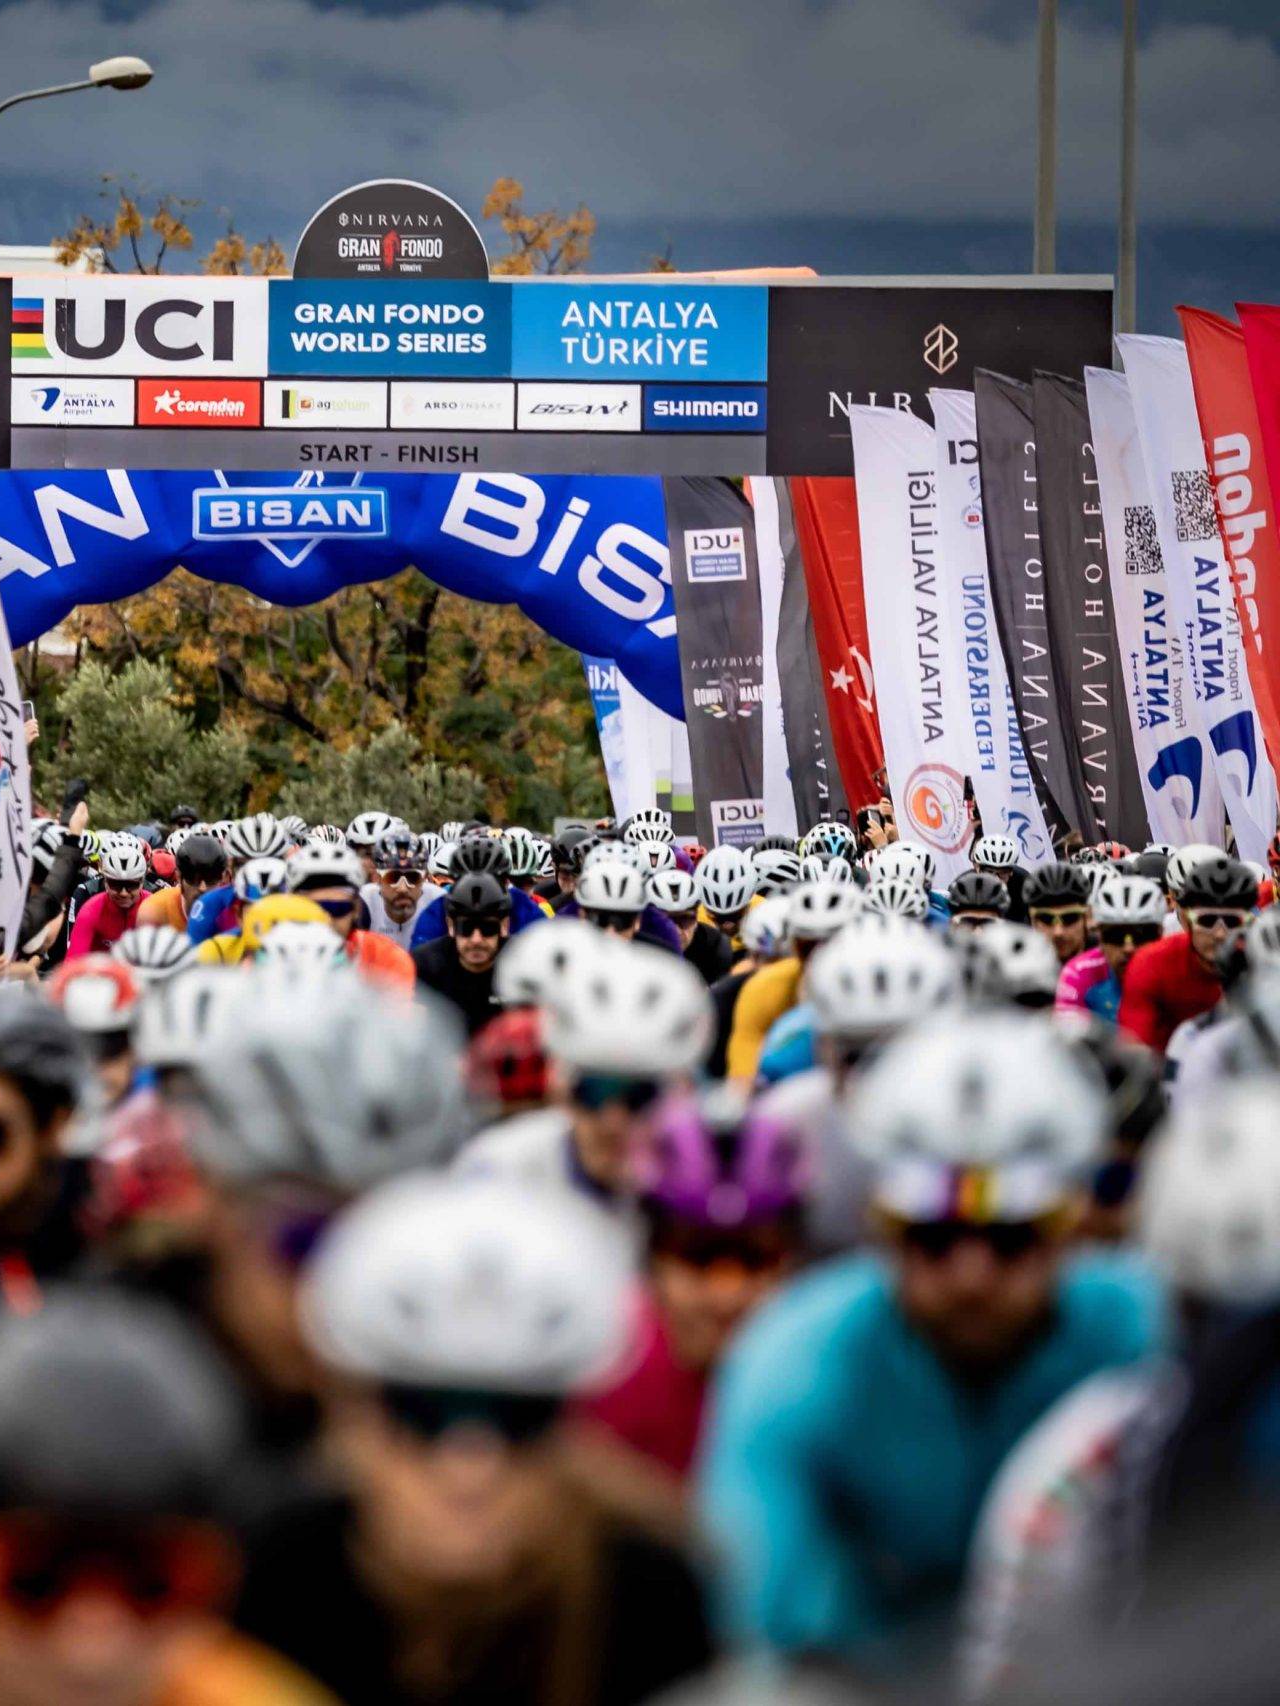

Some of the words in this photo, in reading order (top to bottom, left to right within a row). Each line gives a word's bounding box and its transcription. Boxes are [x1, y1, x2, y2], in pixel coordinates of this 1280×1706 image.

[352, 214, 443, 227] NIRVANA
[338, 237, 381, 258] GRAN
[401, 238, 443, 259] FONDO
[295, 304, 375, 325] GRAN
[384, 304, 484, 325] FONDO
[562, 301, 719, 329] ANTALYA
[55, 298, 234, 361] UCI
[290, 332, 390, 353] WORLD
[396, 333, 487, 353] SERIES
[561, 332, 708, 366] TÜRKİYE
[63, 408, 93, 417] Airport
[64, 399, 115, 408] ANTALYA
[177, 398, 245, 414] corendon
[530, 403, 617, 415] BISAN
[653, 400, 758, 417] SHIMANO
[299, 444, 373, 462] START
[398, 445, 479, 463] FINISH
